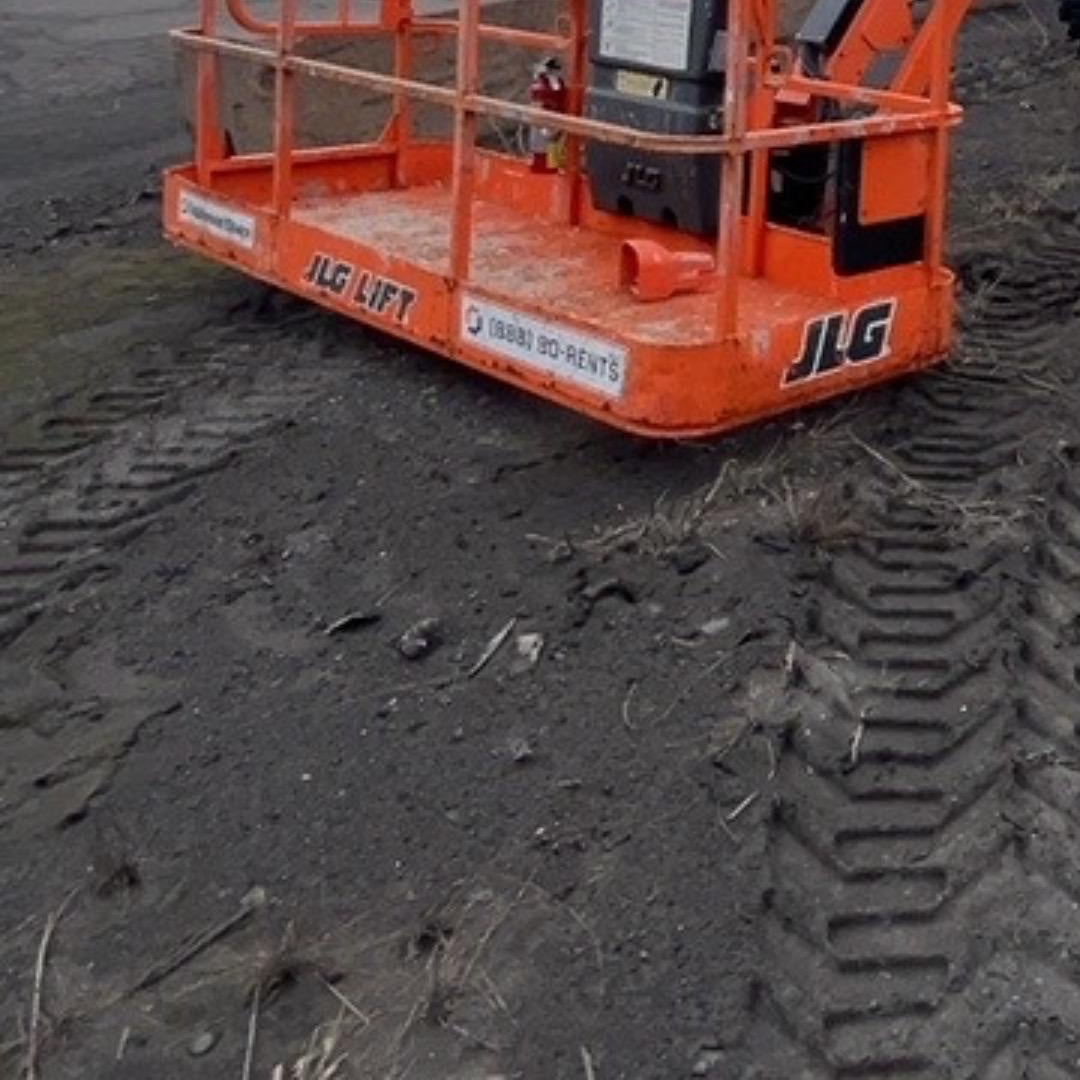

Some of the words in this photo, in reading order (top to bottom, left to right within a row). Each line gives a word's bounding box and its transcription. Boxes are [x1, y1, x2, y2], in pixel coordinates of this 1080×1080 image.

[303, 253, 353, 295] JLG
[353, 272, 417, 324] LIFT
[781, 298, 896, 387] JLG
